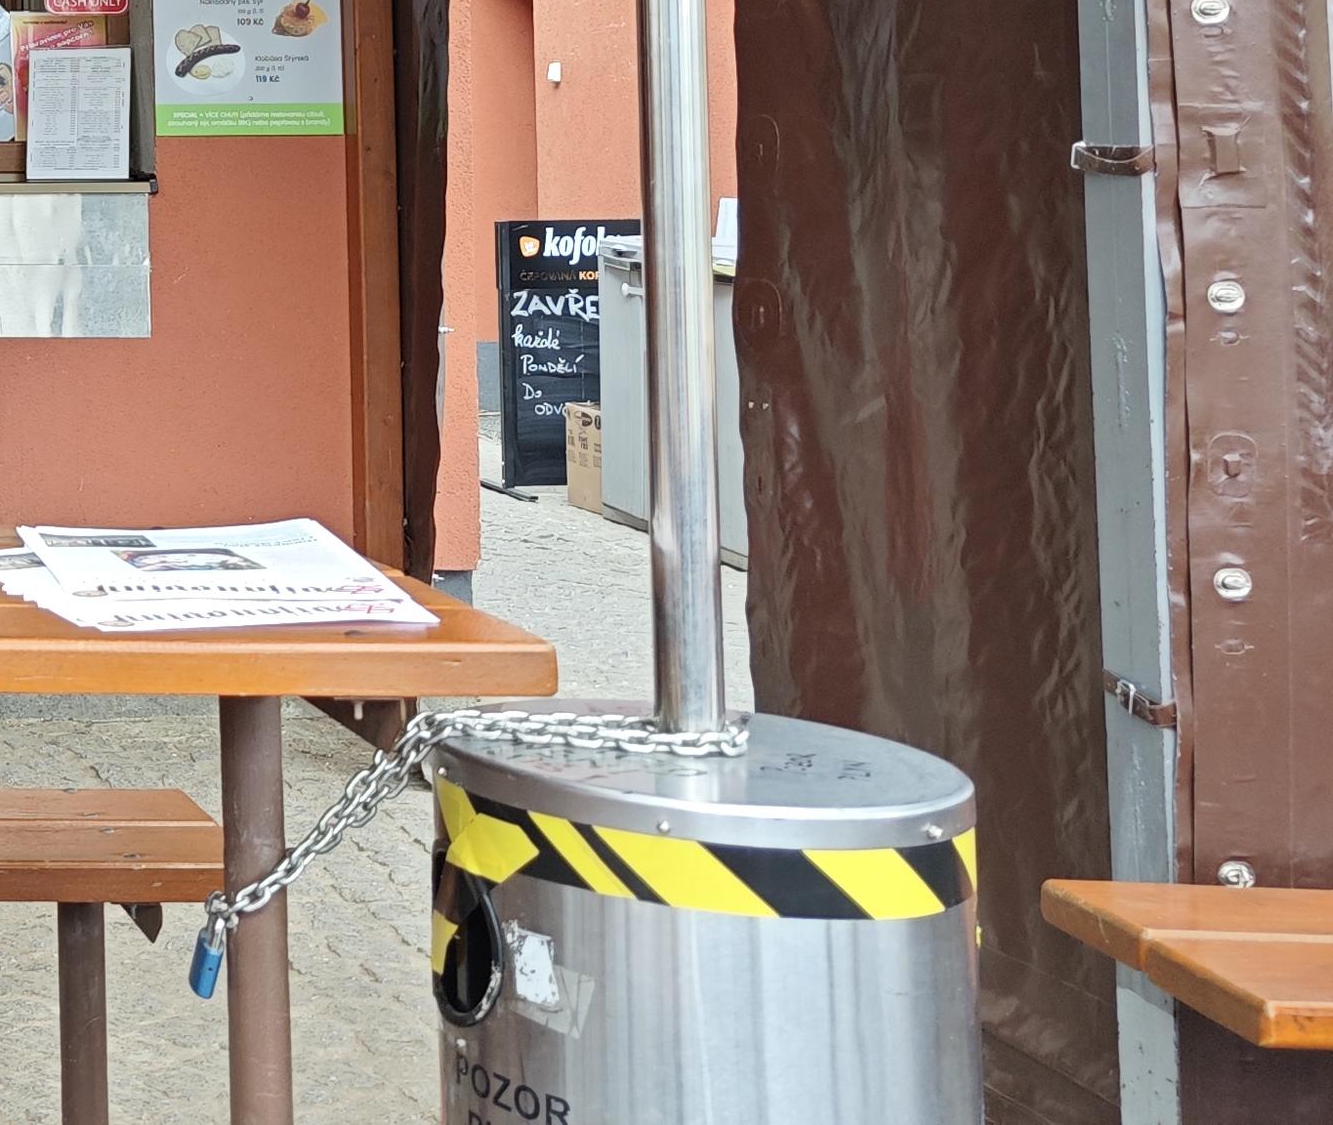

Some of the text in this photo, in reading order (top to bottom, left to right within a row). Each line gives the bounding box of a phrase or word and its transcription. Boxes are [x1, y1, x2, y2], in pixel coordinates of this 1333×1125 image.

[254, 17, 264, 25] Kč
[543, 226, 615, 265] kofol
[511, 288, 600, 322] ZAVŘE
[512, 324, 561, 350] každé
[456, 1051, 571, 1125] POZOR
